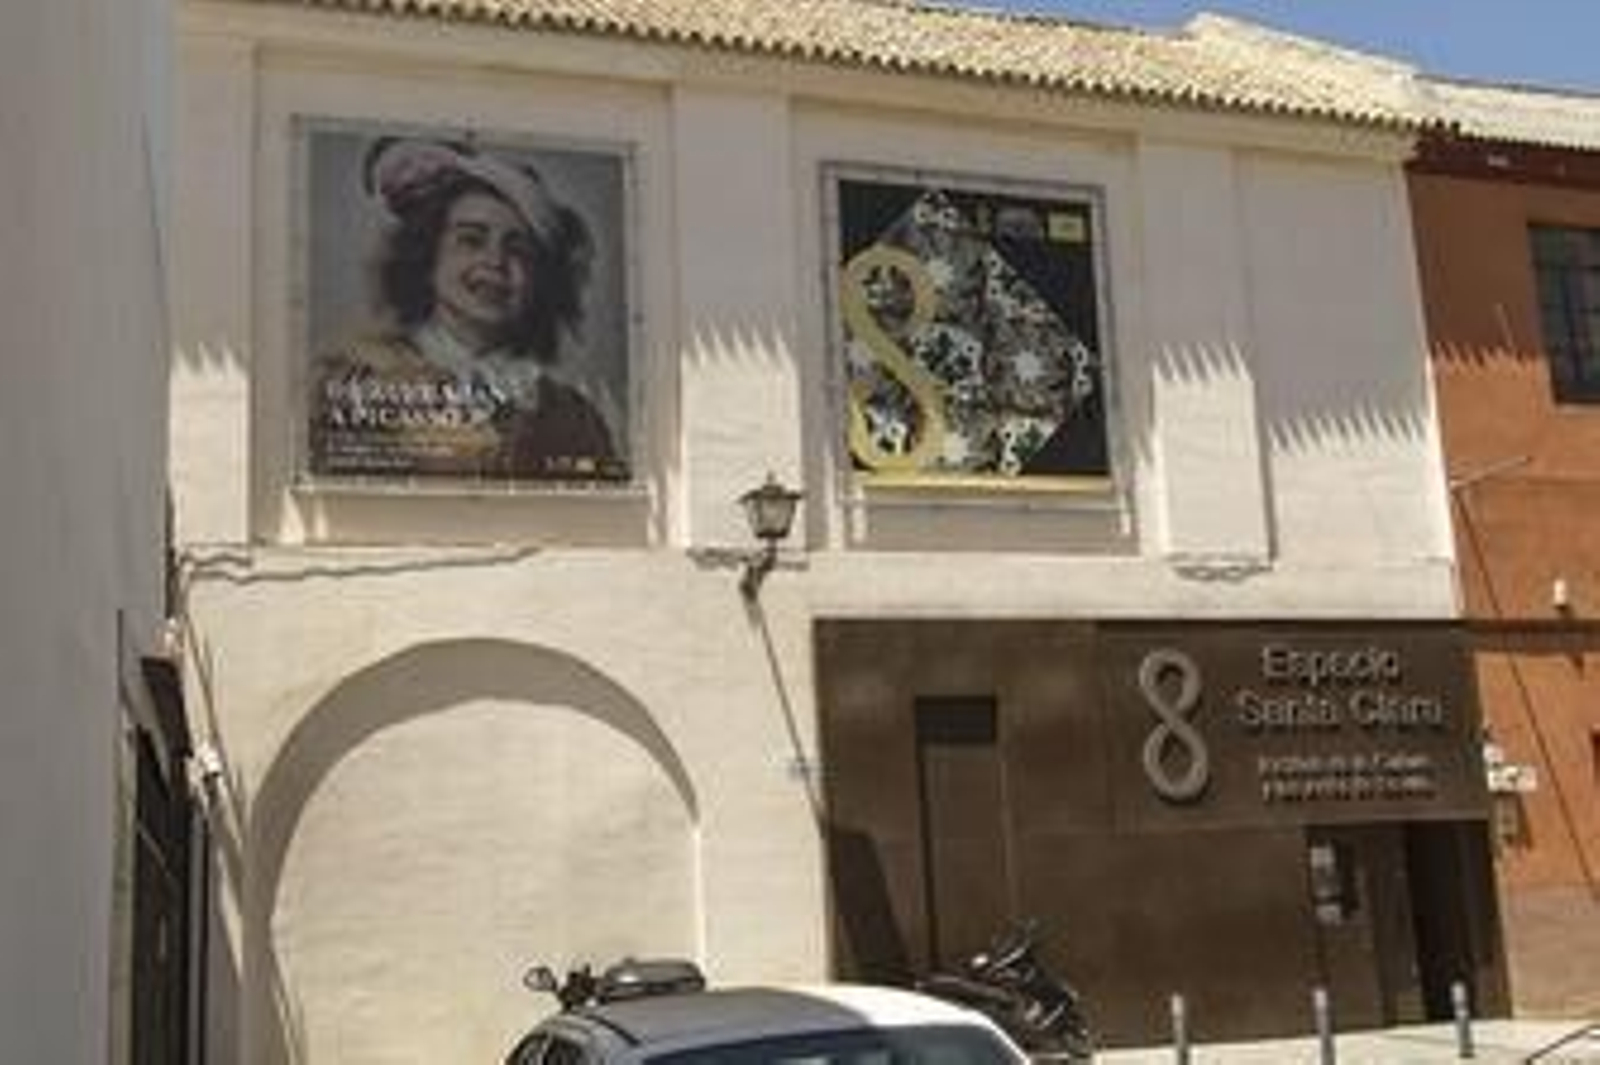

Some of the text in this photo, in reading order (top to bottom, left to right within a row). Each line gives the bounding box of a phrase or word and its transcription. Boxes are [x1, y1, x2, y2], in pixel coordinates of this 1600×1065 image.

[1261, 643, 1399, 686] Espacio
[1236, 689, 1442, 726] Santa Clara
